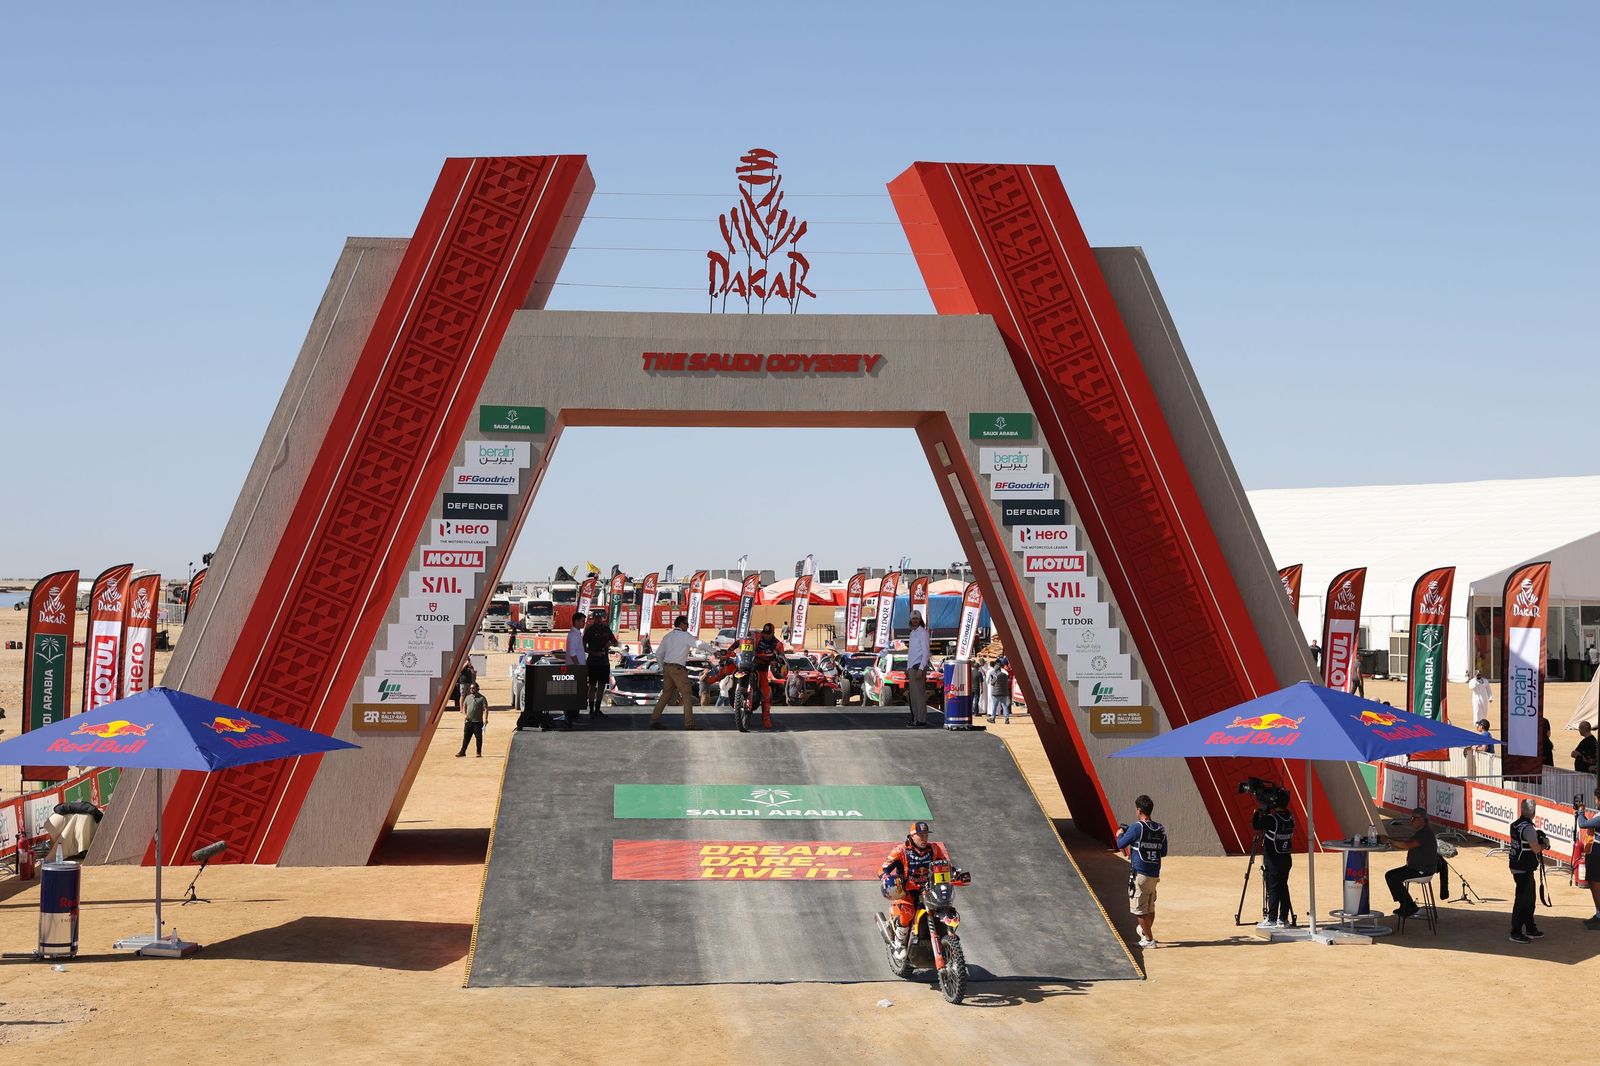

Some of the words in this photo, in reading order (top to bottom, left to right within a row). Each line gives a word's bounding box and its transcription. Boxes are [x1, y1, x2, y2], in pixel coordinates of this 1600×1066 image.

[707, 250, 816, 299] DAKAR
[642, 352, 688, 371] THE
[688, 353, 764, 372] SAUDI
[766, 354, 881, 373] ODYSSEY
[480, 445, 515, 457] berain
[994, 451, 1028, 463] berain
[458, 475, 515, 483] BFGoodrich
[447, 502, 504, 510] DEFENDER
[1006, 508, 1061, 516] DEFENDER
[455, 524, 489, 535] Hero
[1035, 530, 1068, 540] Hero
[426, 552, 481, 566] MOTUL
[1029, 558, 1082, 570] MOTUL
[98, 600, 122, 612] DAKAR
[1334, 601, 1356, 612] DAKAR
[1420, 603, 1445, 616] DAKAR
[1513, 604, 1541, 618] DAKAR
[39, 610, 67, 625] DAKAR
[131, 608, 151, 620] DAKAR
[416, 614, 450, 622] TUDOR
[740, 597, 750, 638] DEFENDER
[796, 604, 804, 626] Hero
[850, 605, 859, 638] MOTUL
[880, 607, 889, 636] TUDOR
[129, 643, 145, 692] Hero
[1330, 636, 1349, 691] OTUL
[1424, 656, 1434, 696] ARABIA
[43, 669, 54, 711] ARABIA
[1511, 667, 1527, 717] berain
[224, 733, 255, 749] Red
[252, 730, 289, 745] Bull
[1204, 731, 1252, 745] Red
[1248, 732, 1302, 746] Bull
[1372, 727, 1404, 742] Red
[1400, 724, 1437, 739] Bull
[47, 738, 98, 752] Red
[95, 739, 149, 753] Bull
[768, 809, 863, 817] ARABIA
[1475, 798, 1514, 822] BFGoodrich
[699, 845, 862, 856] DREAM.
[1146, 851, 1157, 860] 15
[699, 856, 826, 867] DARE.
[699, 867, 796, 878] LIVE
[805, 867, 853, 878] IT.
[940, 873, 946, 882] 1
